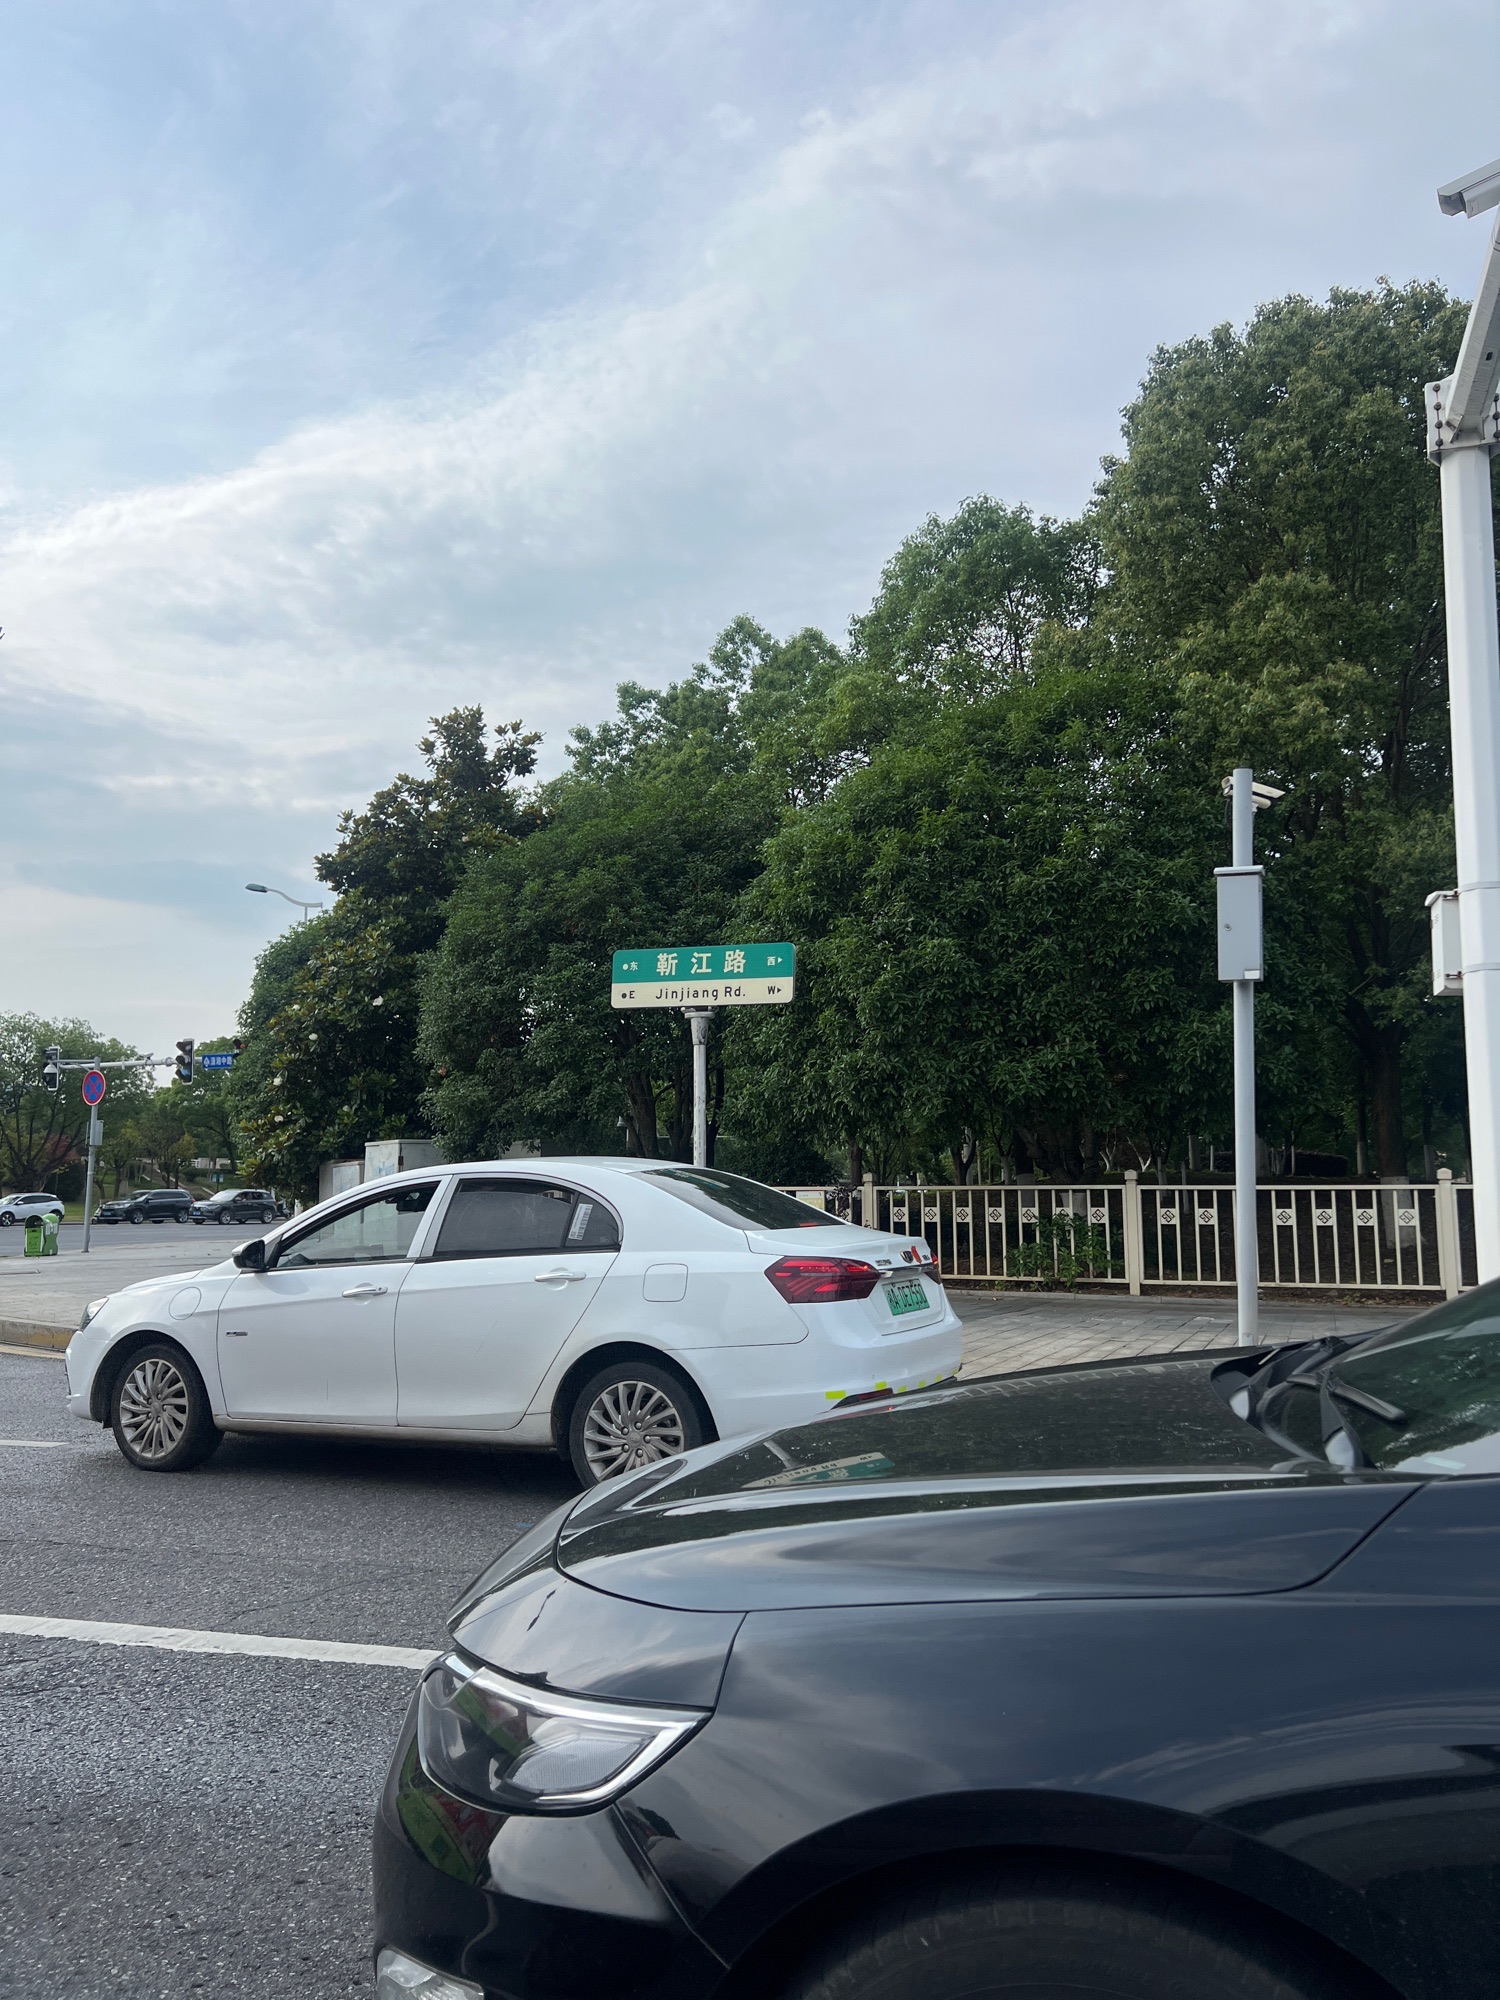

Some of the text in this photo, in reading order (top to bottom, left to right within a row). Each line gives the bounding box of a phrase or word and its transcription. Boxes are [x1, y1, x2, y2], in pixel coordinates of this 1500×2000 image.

[629, 949, 776, 976] 东 靳江路 西
[629, 986, 776, 1002] E Jinjiang Rd. W
